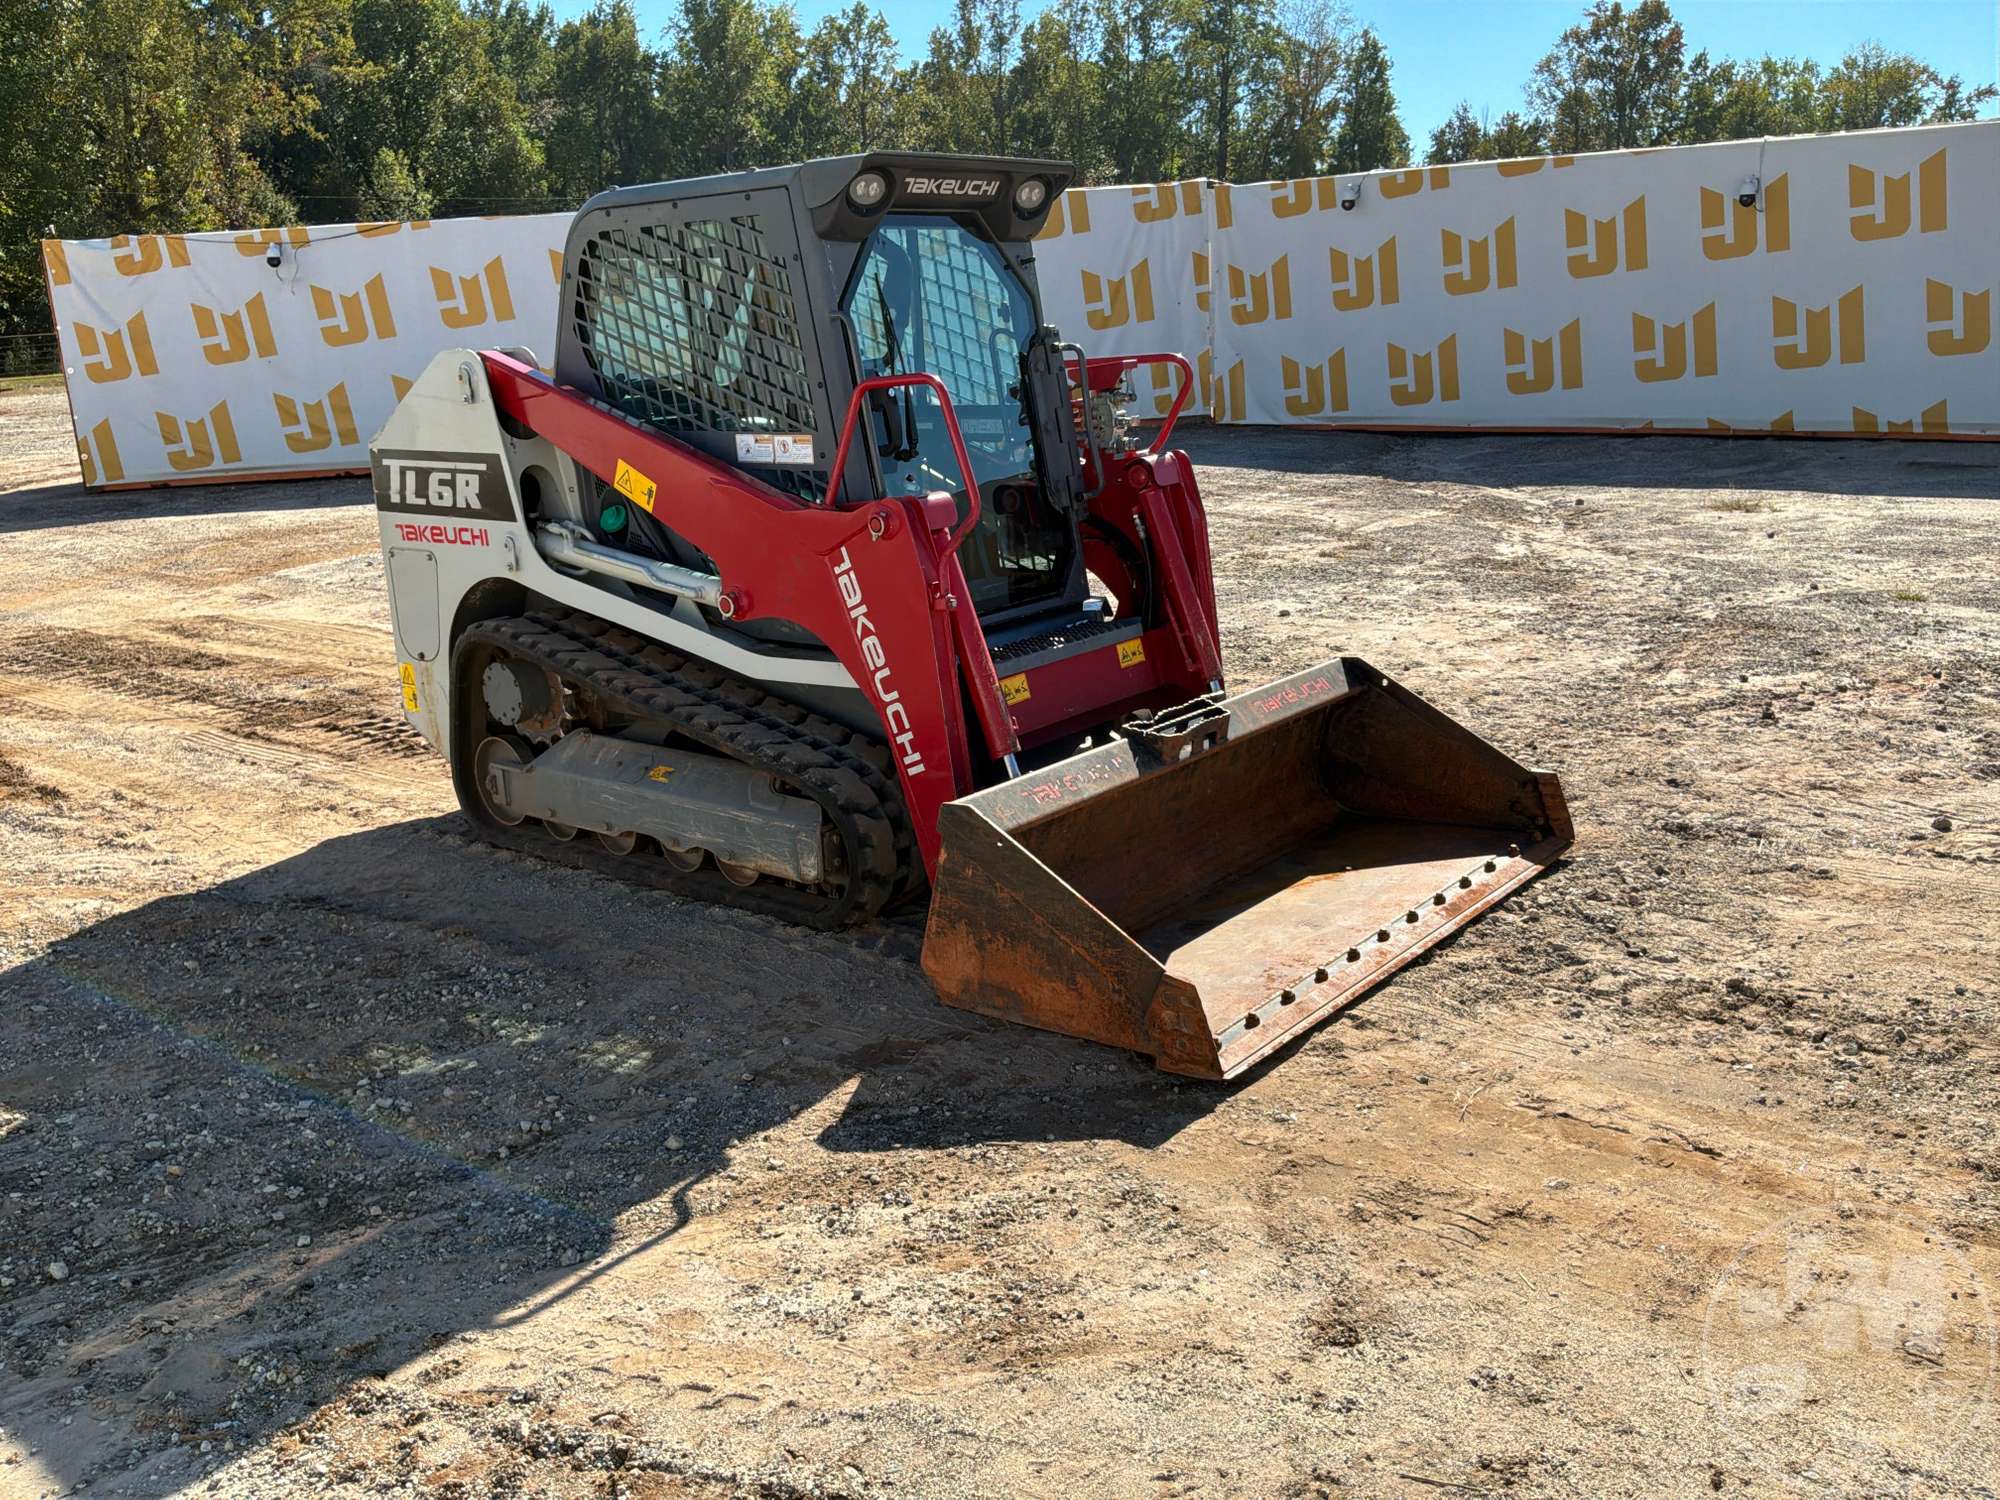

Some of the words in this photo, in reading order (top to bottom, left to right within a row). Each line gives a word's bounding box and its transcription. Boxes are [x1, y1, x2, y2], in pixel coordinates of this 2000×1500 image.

[903, 177, 1000, 197] TAKEUCHI
[382, 458, 487, 510] TL6R
[394, 523, 490, 547] TAKEUCHI
[833, 545, 926, 776] TAKEUCHI
